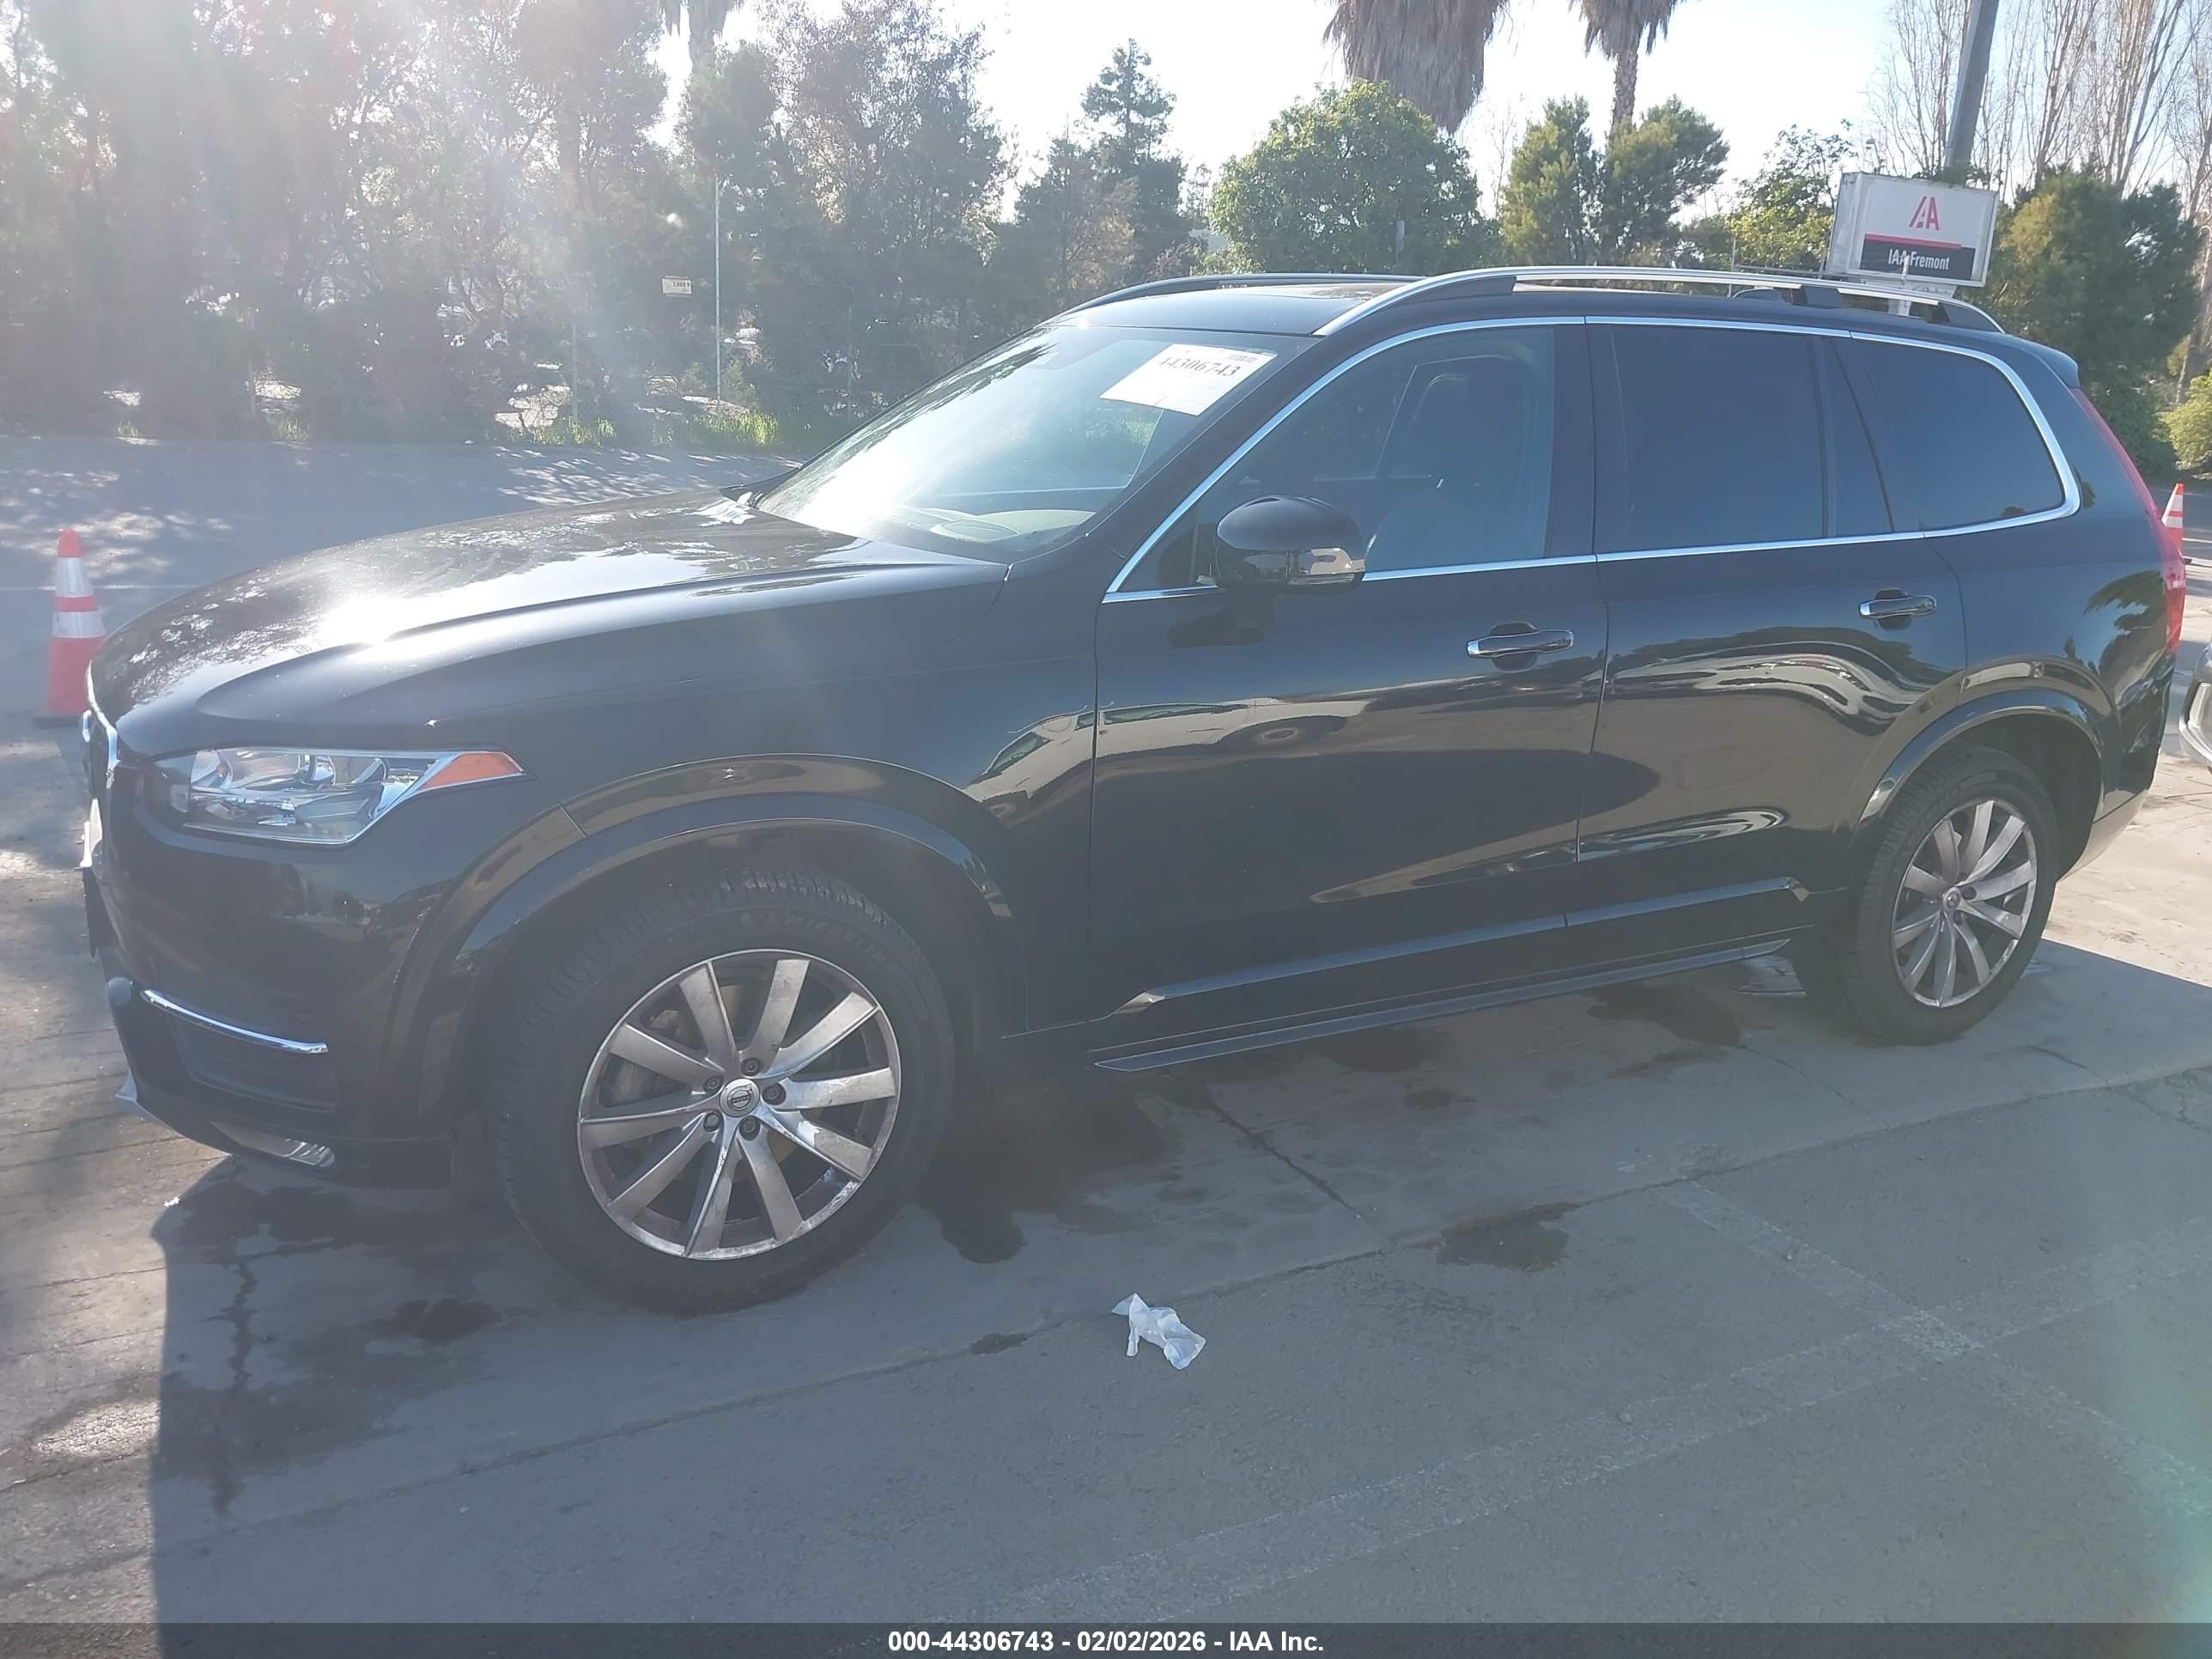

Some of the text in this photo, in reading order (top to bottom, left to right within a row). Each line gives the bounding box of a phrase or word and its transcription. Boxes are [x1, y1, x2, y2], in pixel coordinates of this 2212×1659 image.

[1887, 248, 1951, 270] IAA Fremont
[1158, 356, 1242, 377] 44306743
